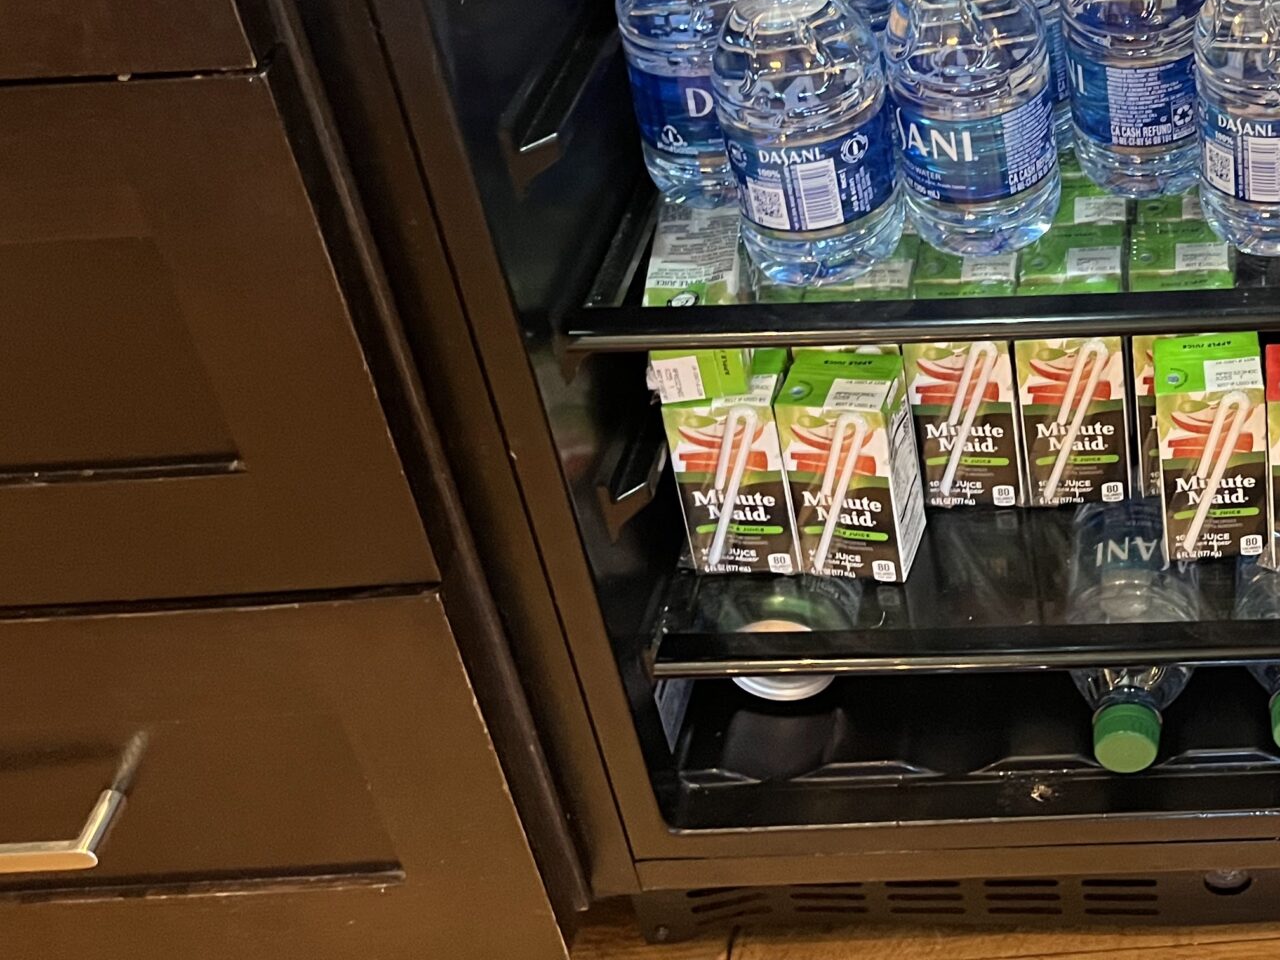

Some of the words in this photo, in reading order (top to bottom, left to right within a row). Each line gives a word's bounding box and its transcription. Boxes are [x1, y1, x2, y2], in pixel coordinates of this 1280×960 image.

[1111, 125, 1120, 136] CA
[1121, 126, 1141, 138] CASH
[1142, 122, 1172, 138] REFUND
[1218, 114, 1272, 137] DASANI
[759, 147, 821, 167] DASANI
[1009, 172, 1019, 186] CA
[1019, 165, 1036, 182] CASH
[956, 481, 982, 489] JUICE
[1064, 480, 1091, 489] JUICE
[1106, 484, 1119, 494] 80
[998, 487, 1010, 497] 80
[1202, 532, 1230, 541] JUICE
[1246, 537, 1258, 546] 80
[729, 548, 757, 557] JUICE
[835, 552, 861, 562] JUICE
[773, 555, 786, 564] 80
